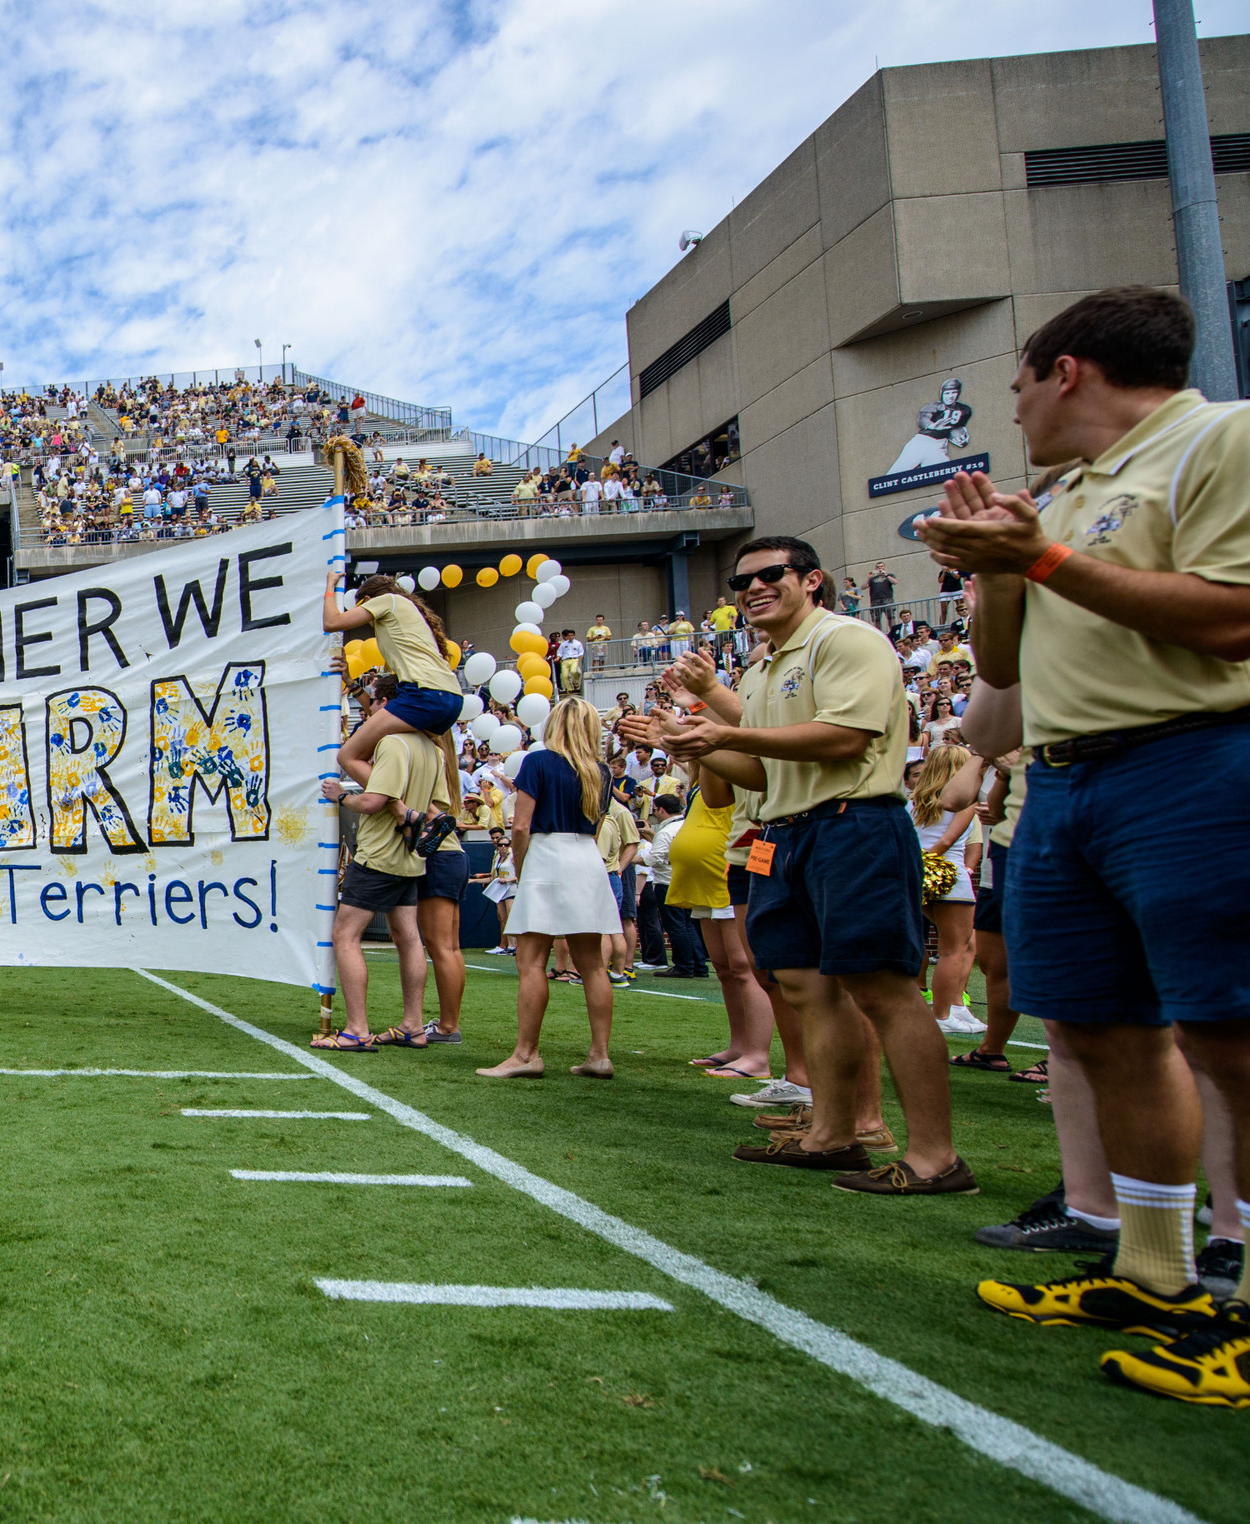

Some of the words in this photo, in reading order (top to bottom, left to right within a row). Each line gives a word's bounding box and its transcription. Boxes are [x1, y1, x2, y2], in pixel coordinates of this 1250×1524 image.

[943, 409, 962, 425] 19
[873, 479, 899, 491] CLINT
[901, 464, 963, 485] CASTLEBERRY
[965, 461, 985, 471] #19
[153, 541, 293, 650] WE
